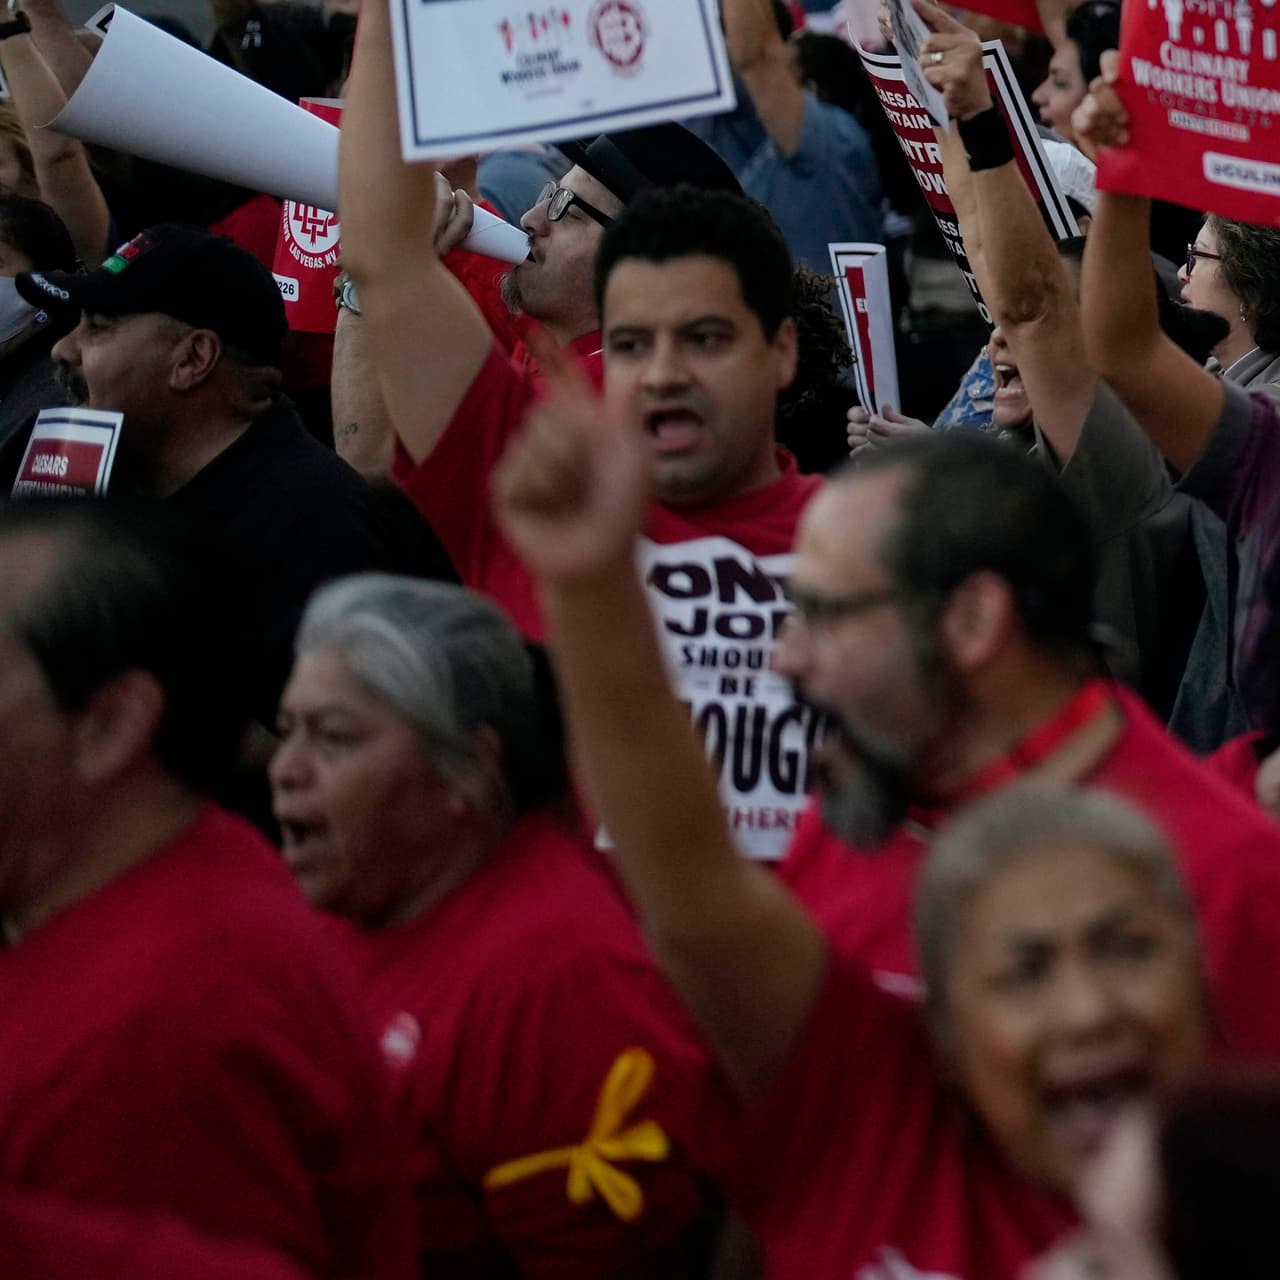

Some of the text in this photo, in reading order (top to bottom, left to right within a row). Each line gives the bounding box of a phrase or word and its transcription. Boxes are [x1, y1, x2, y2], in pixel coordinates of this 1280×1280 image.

[1159, 39, 1250, 84] CULINARY
[1131, 56, 1219, 105] WORKERS
[289, 242, 338, 269] LAS VEGAS, NV
[650, 556, 783, 604] ON
[680, 645, 765, 671] SHOU
[718, 675, 757, 698] BE
